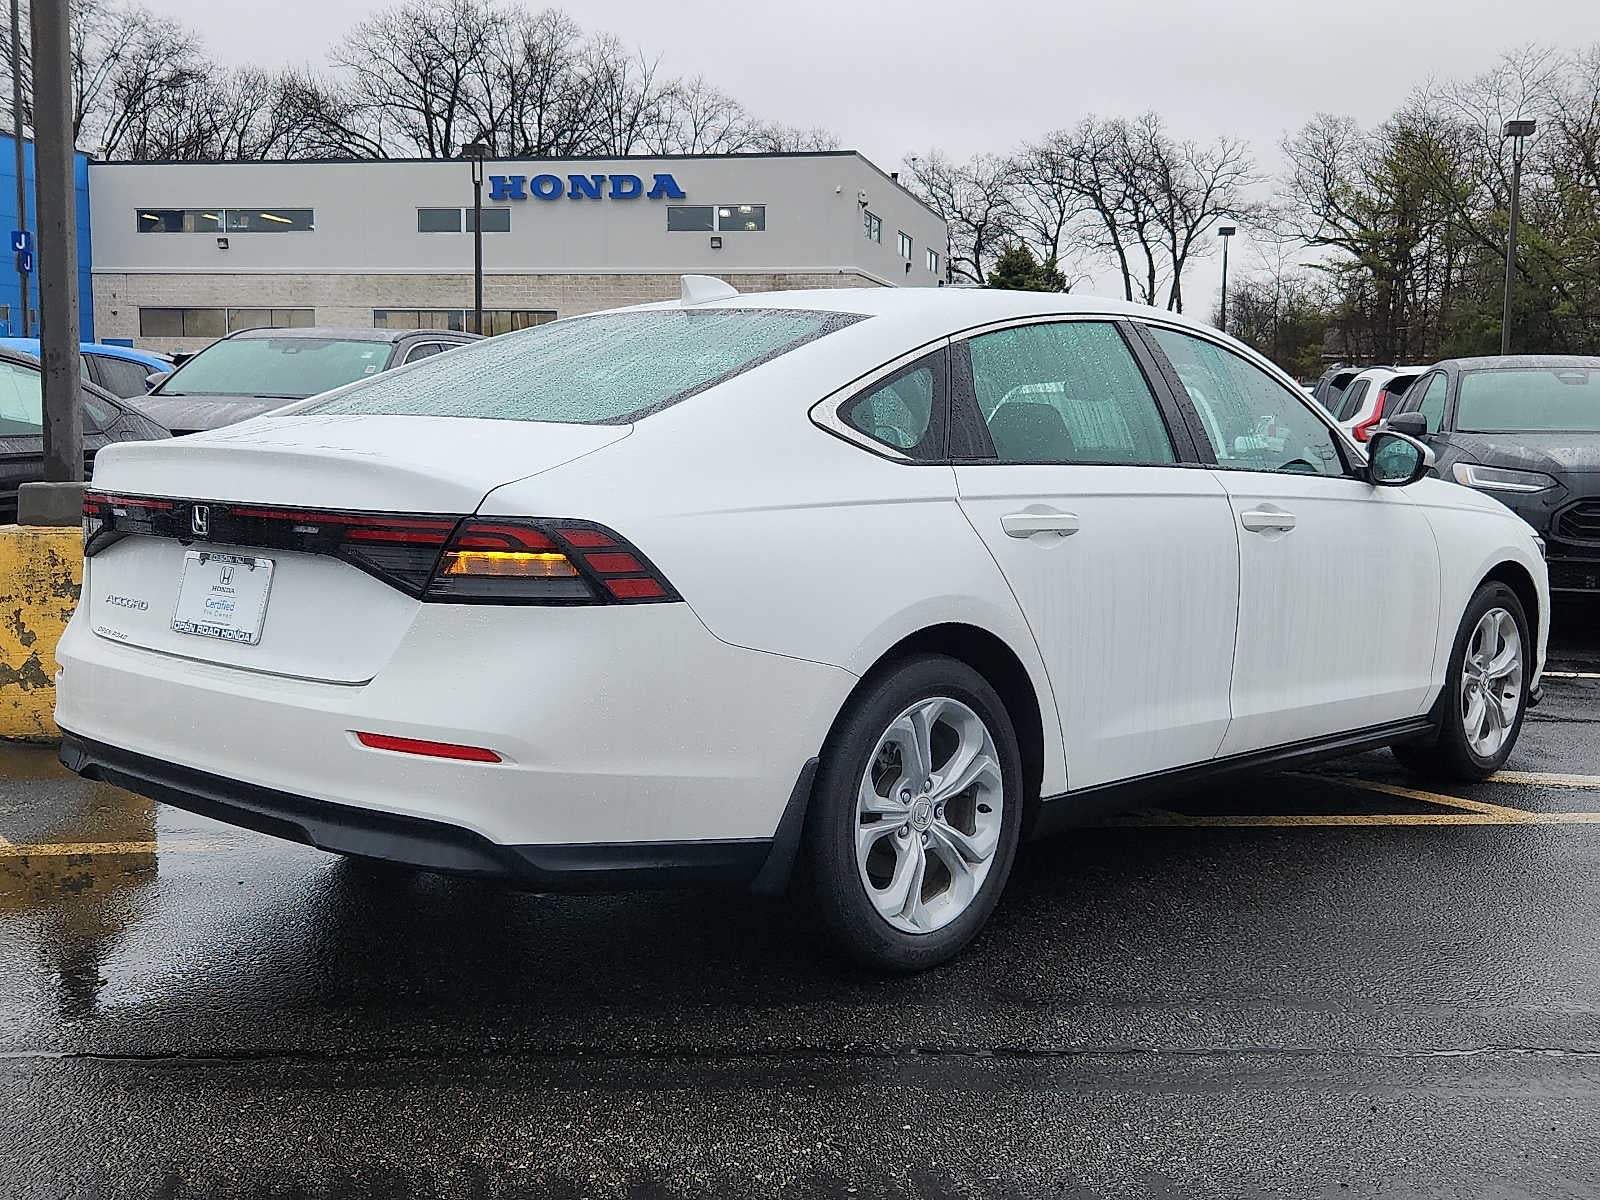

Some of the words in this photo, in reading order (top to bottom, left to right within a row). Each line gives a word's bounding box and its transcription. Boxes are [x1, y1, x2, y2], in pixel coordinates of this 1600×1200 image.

[489, 174, 686, 200] HONDA
[212, 585, 235, 594] HONDA
[105, 594, 149, 611] ACCORD
[205, 598, 236, 611] Certified
[174, 621, 196, 633] OPEN
[196, 626, 220, 637] ROAD
[220, 629, 252, 642] HONDA
